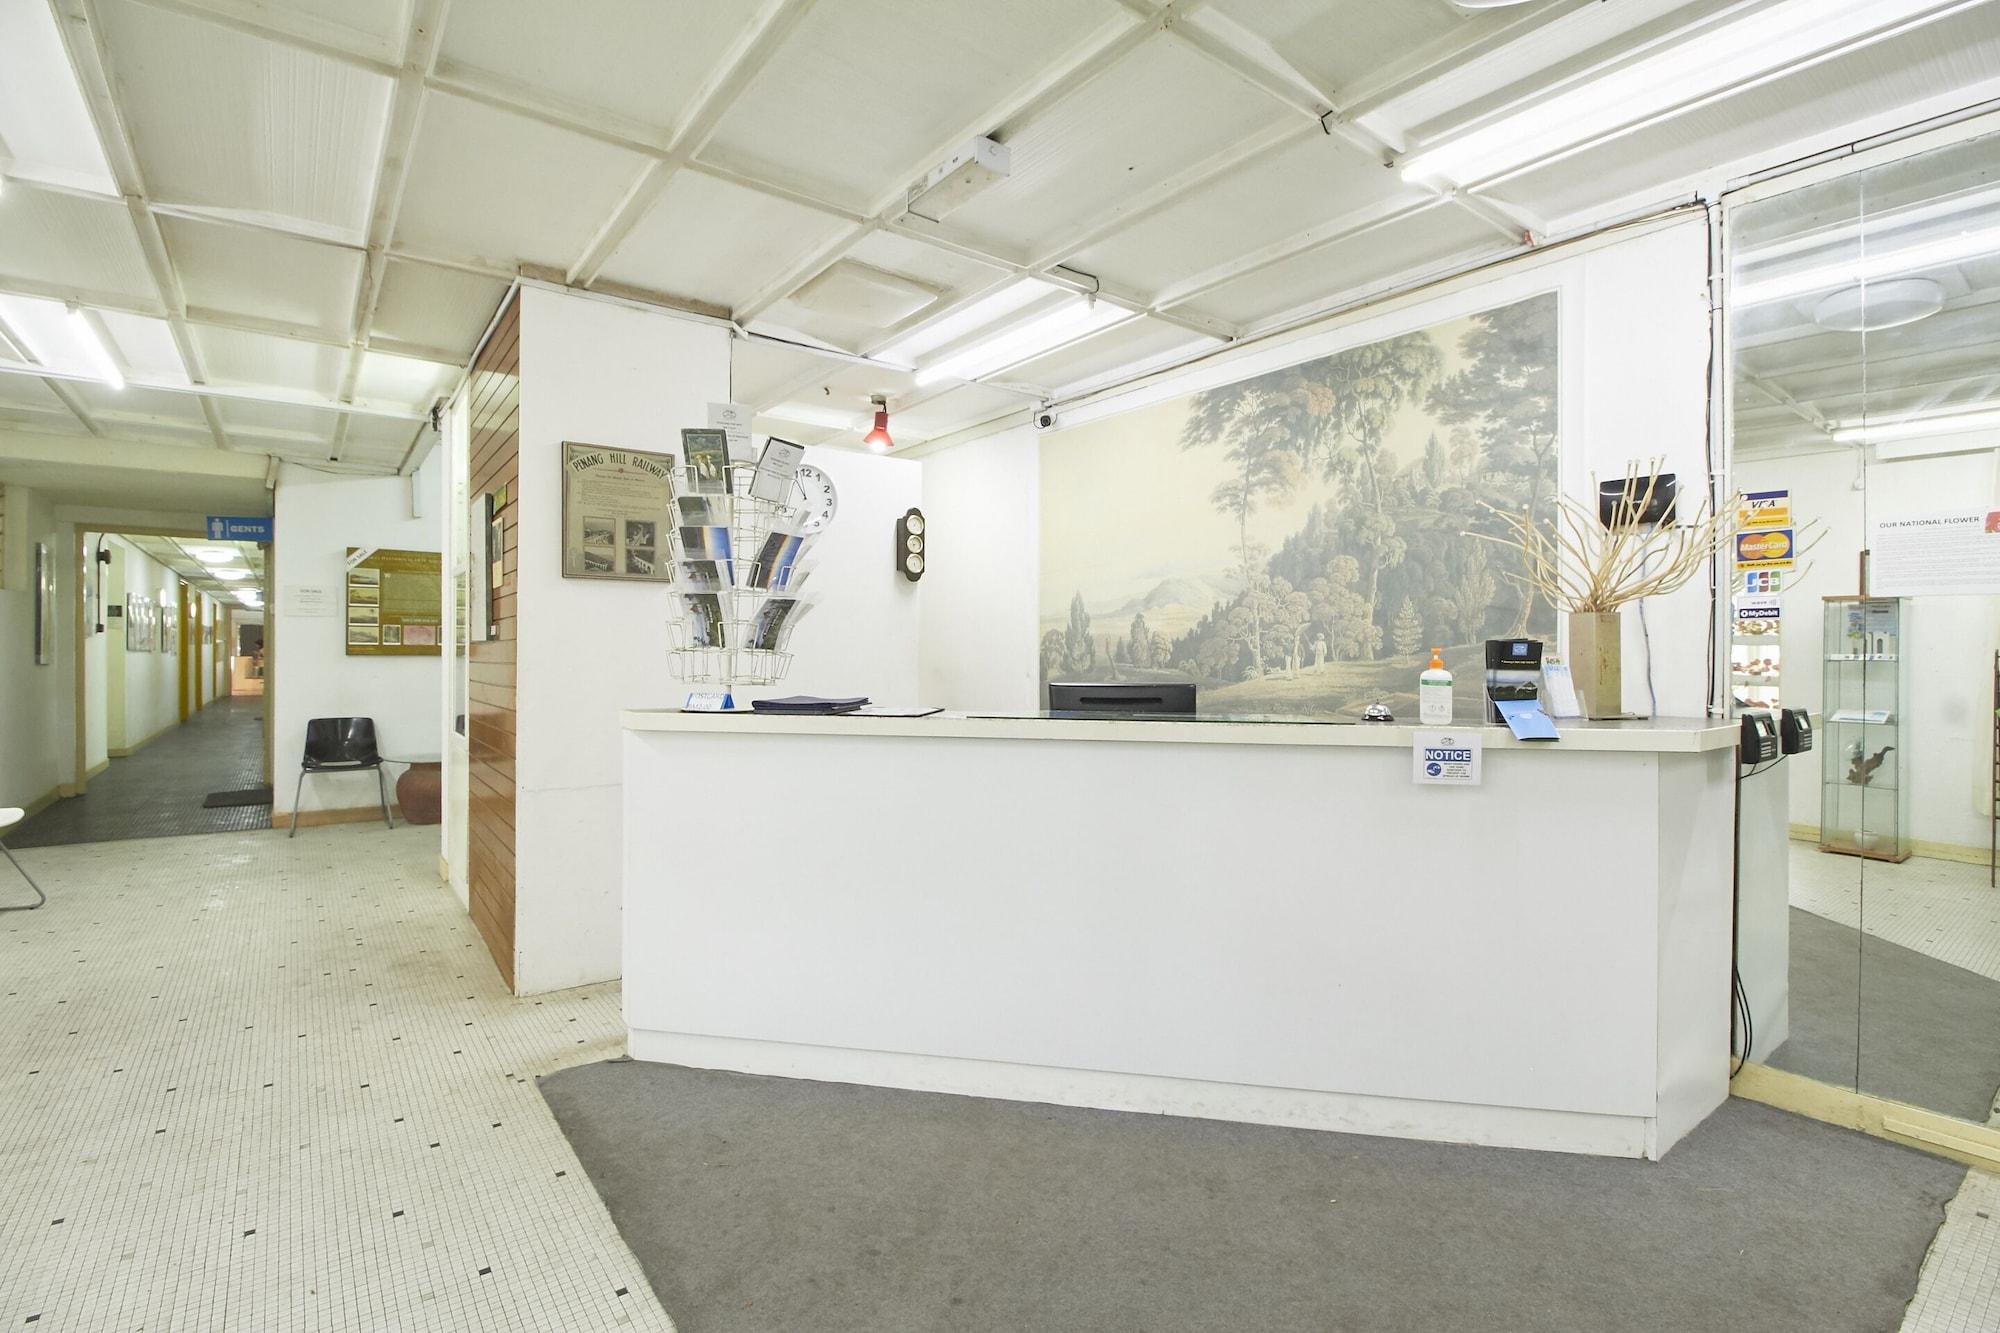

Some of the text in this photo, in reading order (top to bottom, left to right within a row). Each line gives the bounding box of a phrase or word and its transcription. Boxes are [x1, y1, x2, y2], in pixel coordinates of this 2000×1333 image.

[572, 453, 604, 472] PENANG
[609, 453, 627, 465] HILL
[632, 456, 667, 479] RAILWAY
[801, 468, 812, 478] 12
[816, 473, 821, 481] 1
[824, 485, 831, 493] 2
[826, 498, 832, 506] 3
[1752, 499, 1775, 508] VIA
[822, 510, 828, 518] 4
[1900, 519, 1941, 527] NATIONAL
[1944, 516, 1980, 524] FLOWER
[230, 525, 265, 533] GENTS
[1747, 576, 1780, 588] JCB
[1748, 610, 1778, 618] MyDebit
[1426, 750, 1471, 760] NOTICE
